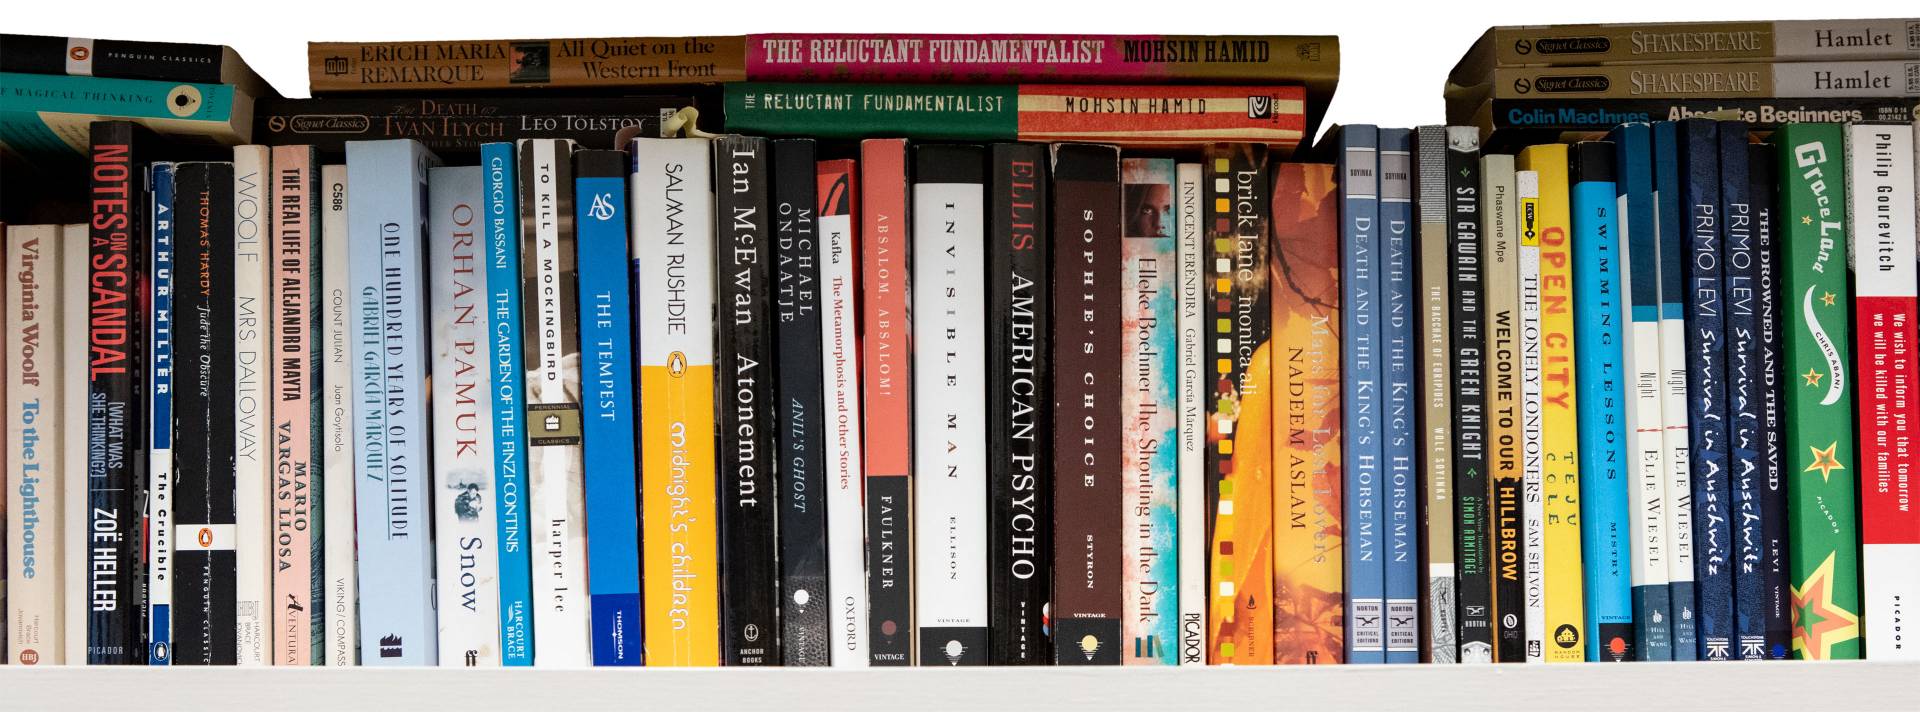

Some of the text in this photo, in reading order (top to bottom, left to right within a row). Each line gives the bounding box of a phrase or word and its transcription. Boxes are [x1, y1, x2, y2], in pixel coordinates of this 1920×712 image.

[108, 52, 212, 64] PENGUIN CLASSICS
[360, 42, 506, 62] ERICH MARIA
[360, 64, 484, 84] REMARQUE
[558, 37, 716, 59] All Quiet on the
[583, 60, 716, 79] Western Front
[763, 39, 1105, 63] THE RELUCTANT FUNDAMENTALIST
[1122, 40, 1200, 63] MOHSIN
[1204, 40, 1270, 63] HAMID
[1570, 38, 1608, 50] Classics
[1630, 70, 1761, 94] SHAKESPEARE
[1631, 30, 1761, 54] SHAKESPEARE
[1814, 70, 1892, 90] Hamlet
[1816, 28, 1892, 48] Hamlet
[1066, 97, 1206, 114] MOHSIN HAMID
[1271, 93, 1279, 124] Harcourt
[1508, 108, 1650, 126] Colin MacInnes
[1538, 77, 1608, 91] Signet Classics
[237, 172, 258, 262] WOOLF
[332, 183, 343, 211] C586
[492, 157, 506, 269] GIORGIO BASSANI
[1010, 160, 1034, 252] ELLIS
[1237, 169, 1258, 281] brick lane
[1494, 185, 1506, 263] Phaswane Mpe
[1873, 133, 1895, 272] Philip Gourevitch
[665, 162, 686, 335] SALMAN RUSHDIE
[778, 202, 794, 322] ONDAATJE
[798, 208, 812, 316] MICHAEL
[831, 232, 842, 264] Kafka
[1696, 204, 1717, 317] PRIMO LEVI
[1731, 203, 1752, 316] PRIMO LEVI
[19, 237, 39, 386] Virginia Woolf
[158, 203, 169, 394] ARTHUR MILLER
[332, 289, 342, 363] COUNT JULIAN
[452, 204, 477, 459] ORHAN PAMUK
[945, 202, 957, 479] INVISIBLE MAN
[1138, 257, 1157, 393] Elleke Boehmer
[1456, 187, 1481, 460] SIR GAWAIN AND THE GREEN KNIGHT
[197, 306, 210, 396] Jude the Obscure
[238, 296, 257, 461] MRS. DALLOWAY
[362, 286, 385, 482] GABRIEL GARCÍA MÁRQUEZ
[596, 290, 615, 421] THE TEMPEST
[1238, 296, 1258, 395] monica ali
[1355, 216, 1375, 561] DEATH AND THE KING'S HORSEMAN
[1431, 286, 1443, 408] THE BACCHAE OF EURIPIDES
[1496, 310, 1514, 471] WELCOME TO OUR
[1638, 372, 1657, 399] Night
[1759, 208, 1779, 491] THE DROWNED AND THE SAVED
[1814, 331, 1840, 389] CHRIS ABANI
[737, 352, 759, 507] Atonement
[1010, 272, 1035, 580] AMERICAN PSYCHO
[1288, 346, 1306, 530] NADEEM ASLAM
[1434, 427, 1446, 500] WOLE SOYINKA
[20, 399, 39, 579] To the Lighthouse
[158, 473, 167, 581] The Crucible
[279, 421, 291, 573] VARGAS LLOSA
[294, 461, 306, 531] MARIO
[1500, 487, 1517, 581] HILLBROW
[1644, 450, 1660, 567] ELIE WIESEL
[1674, 447, 1691, 563] ELIE WIESEL
[1816, 496, 1840, 534] PICADOR
[93, 508, 123, 612] ZOË HELLER
[459, 537, 482, 612] Snow
[548, 519, 568, 612] harper lee
[881, 495, 893, 588] FAULKNER
[1462, 496, 1477, 575] SIMON ARMITAGE
[1528, 519, 1539, 609] SAM SELVON
[1610, 521, 1619, 578] MISTRY
[88, 646, 124, 655] PICADOR
[287, 593, 304, 664] AVENTURA
[507, 626, 516, 659] BRACE
[514, 600, 524, 658] HARCOURT
[845, 596, 856, 651] OXFORD
[1185, 613, 1200, 663] PICADOR
